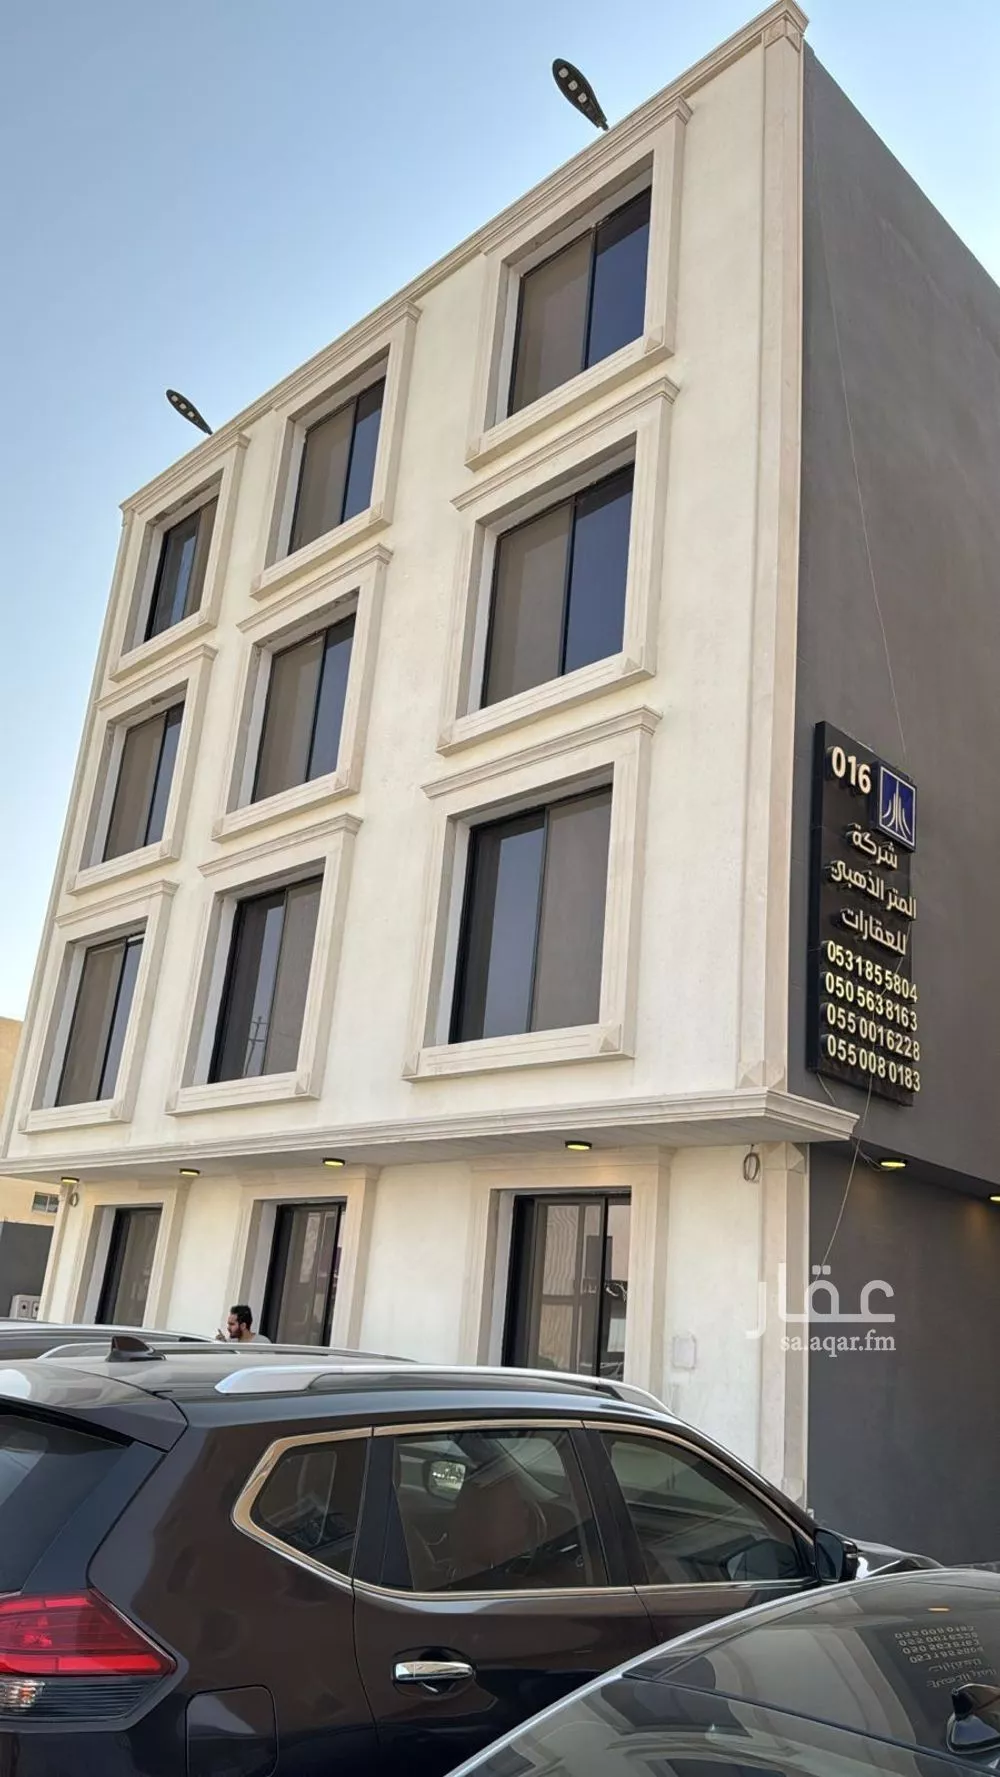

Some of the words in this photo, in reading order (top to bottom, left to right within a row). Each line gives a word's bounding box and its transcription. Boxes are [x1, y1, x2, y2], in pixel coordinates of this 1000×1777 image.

[831, 746, 871, 794] 016
[852, 825, 898, 869] شركة
[831, 860, 885, 901] الذهبي
[886, 886, 917, 920] المتر
[841, 909, 907, 956] للعقارات
